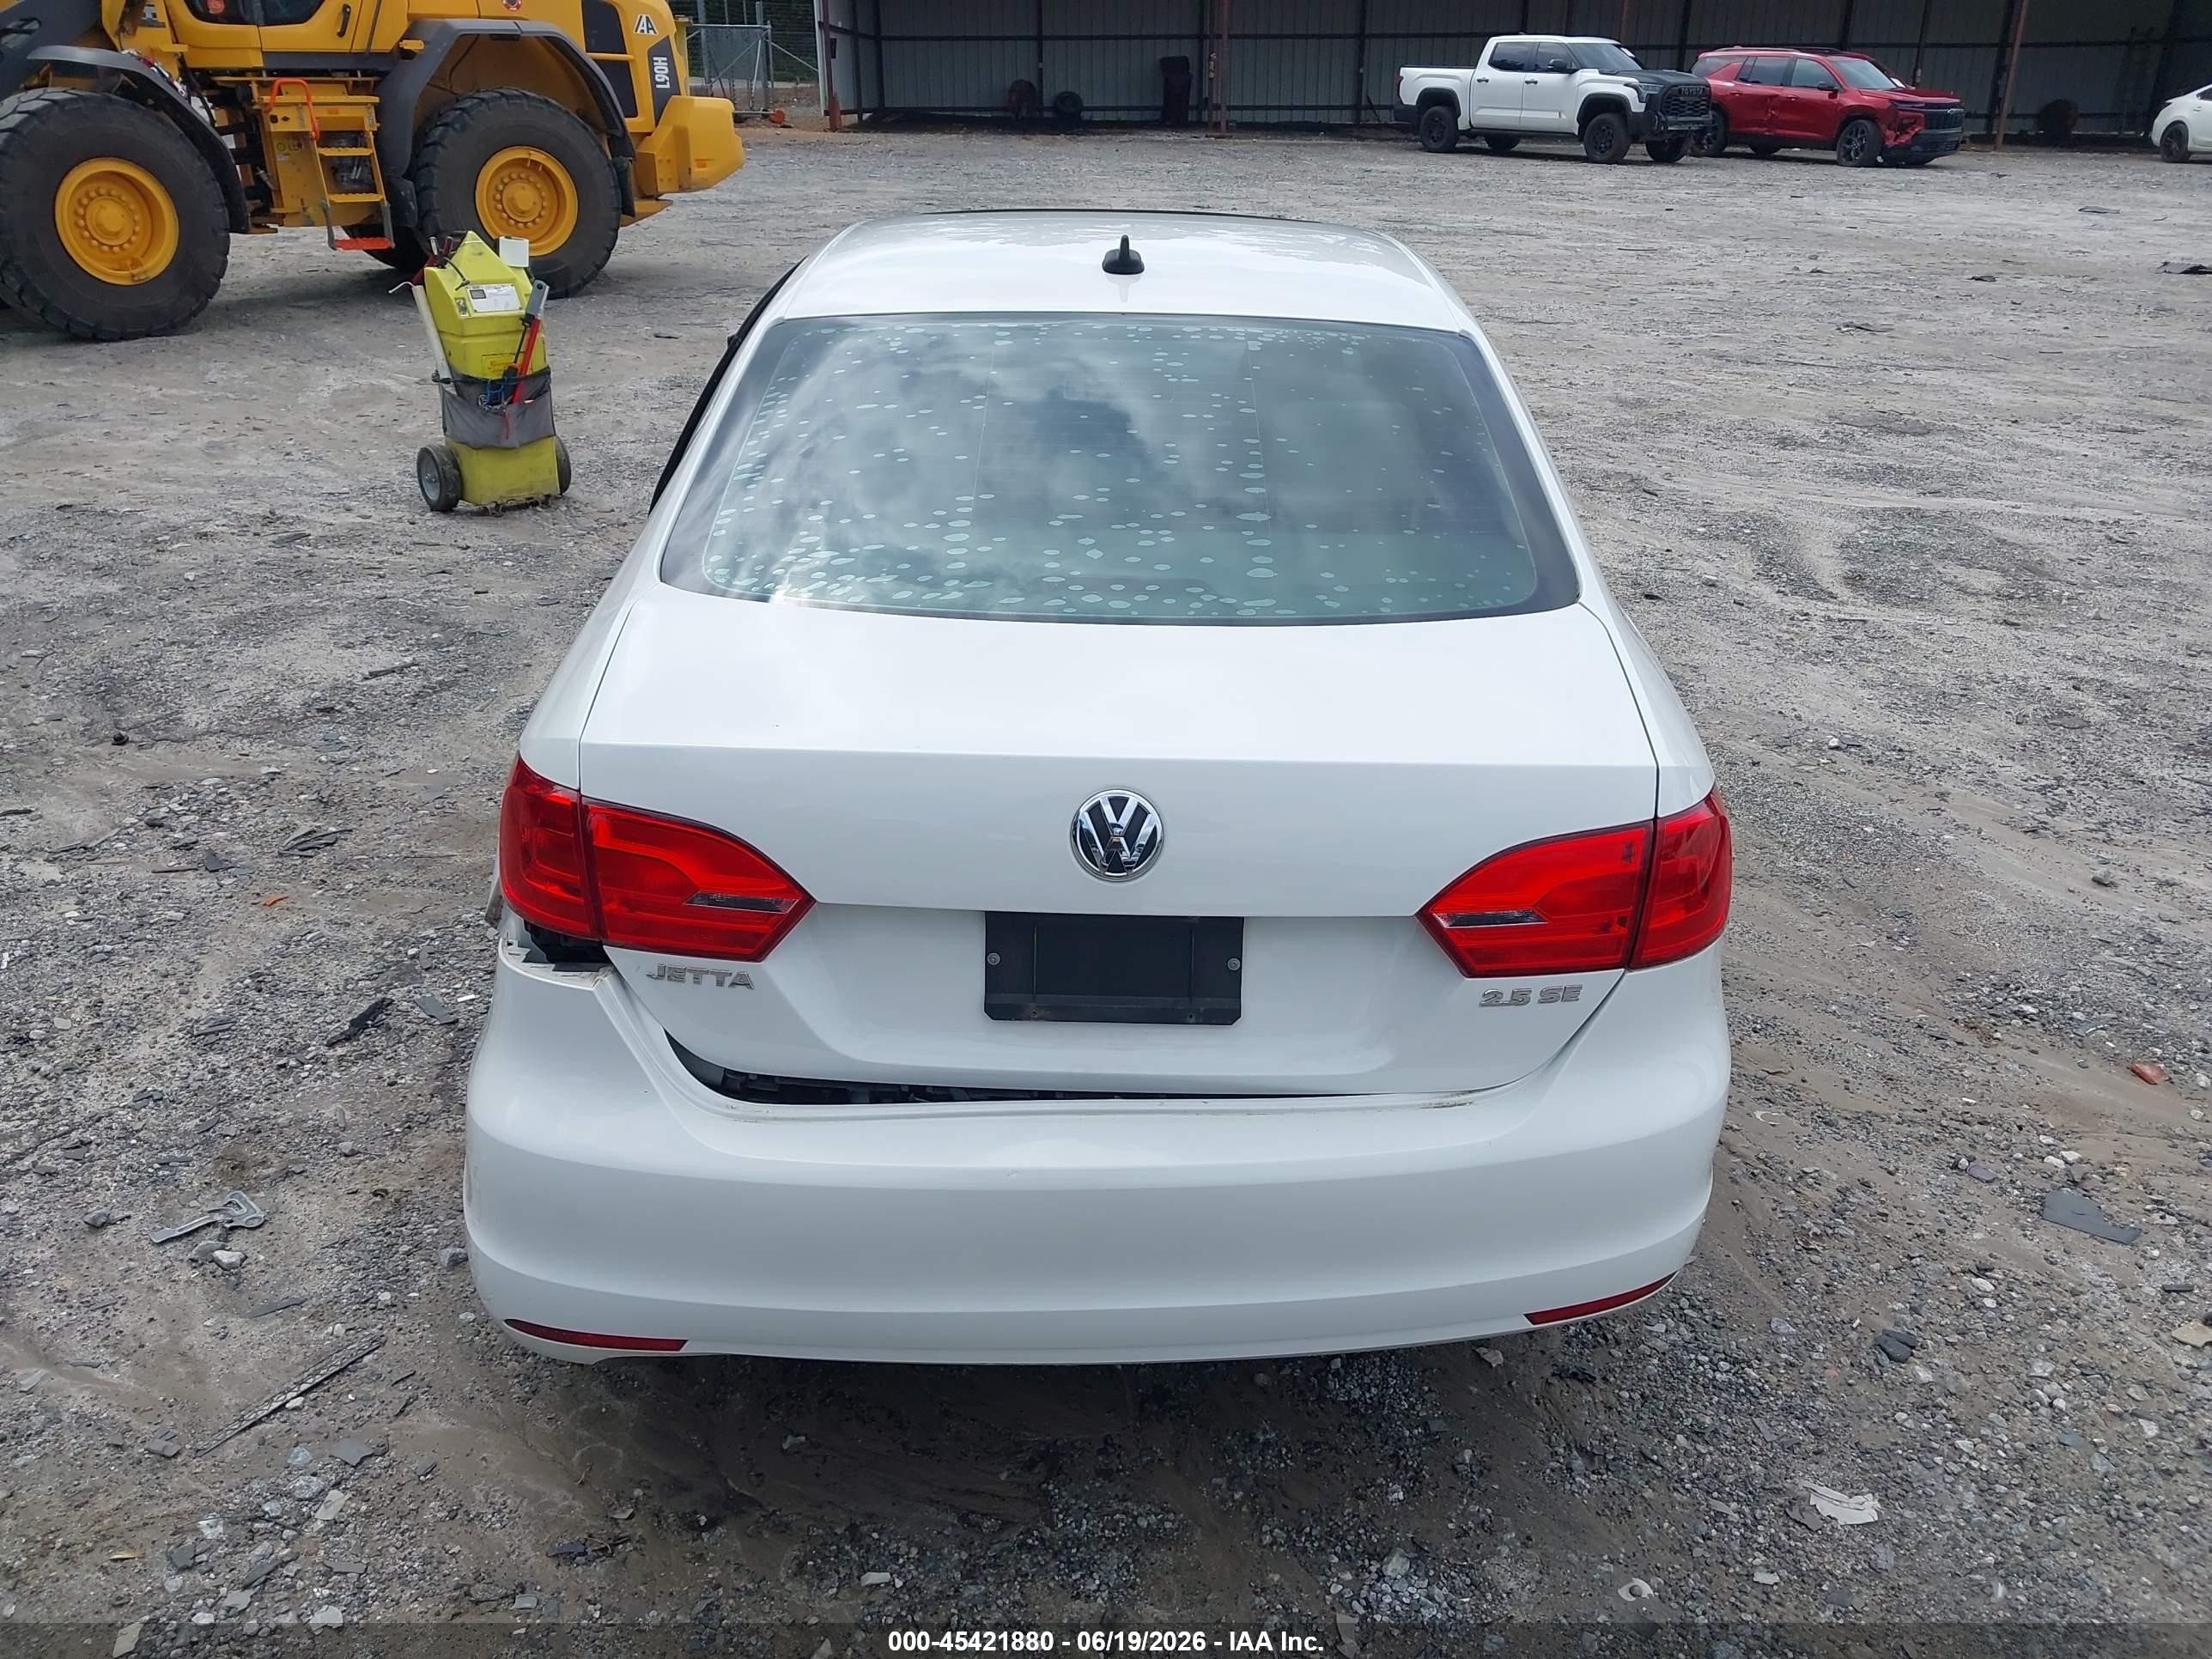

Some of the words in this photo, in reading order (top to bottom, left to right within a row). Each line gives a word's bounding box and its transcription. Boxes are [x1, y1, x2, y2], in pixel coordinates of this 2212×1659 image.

[653, 56, 671, 88] L90H
[646, 963, 755, 990] JETTA
[1479, 988, 1533, 1007] 2.5
[1537, 984, 1583, 1005] SE
